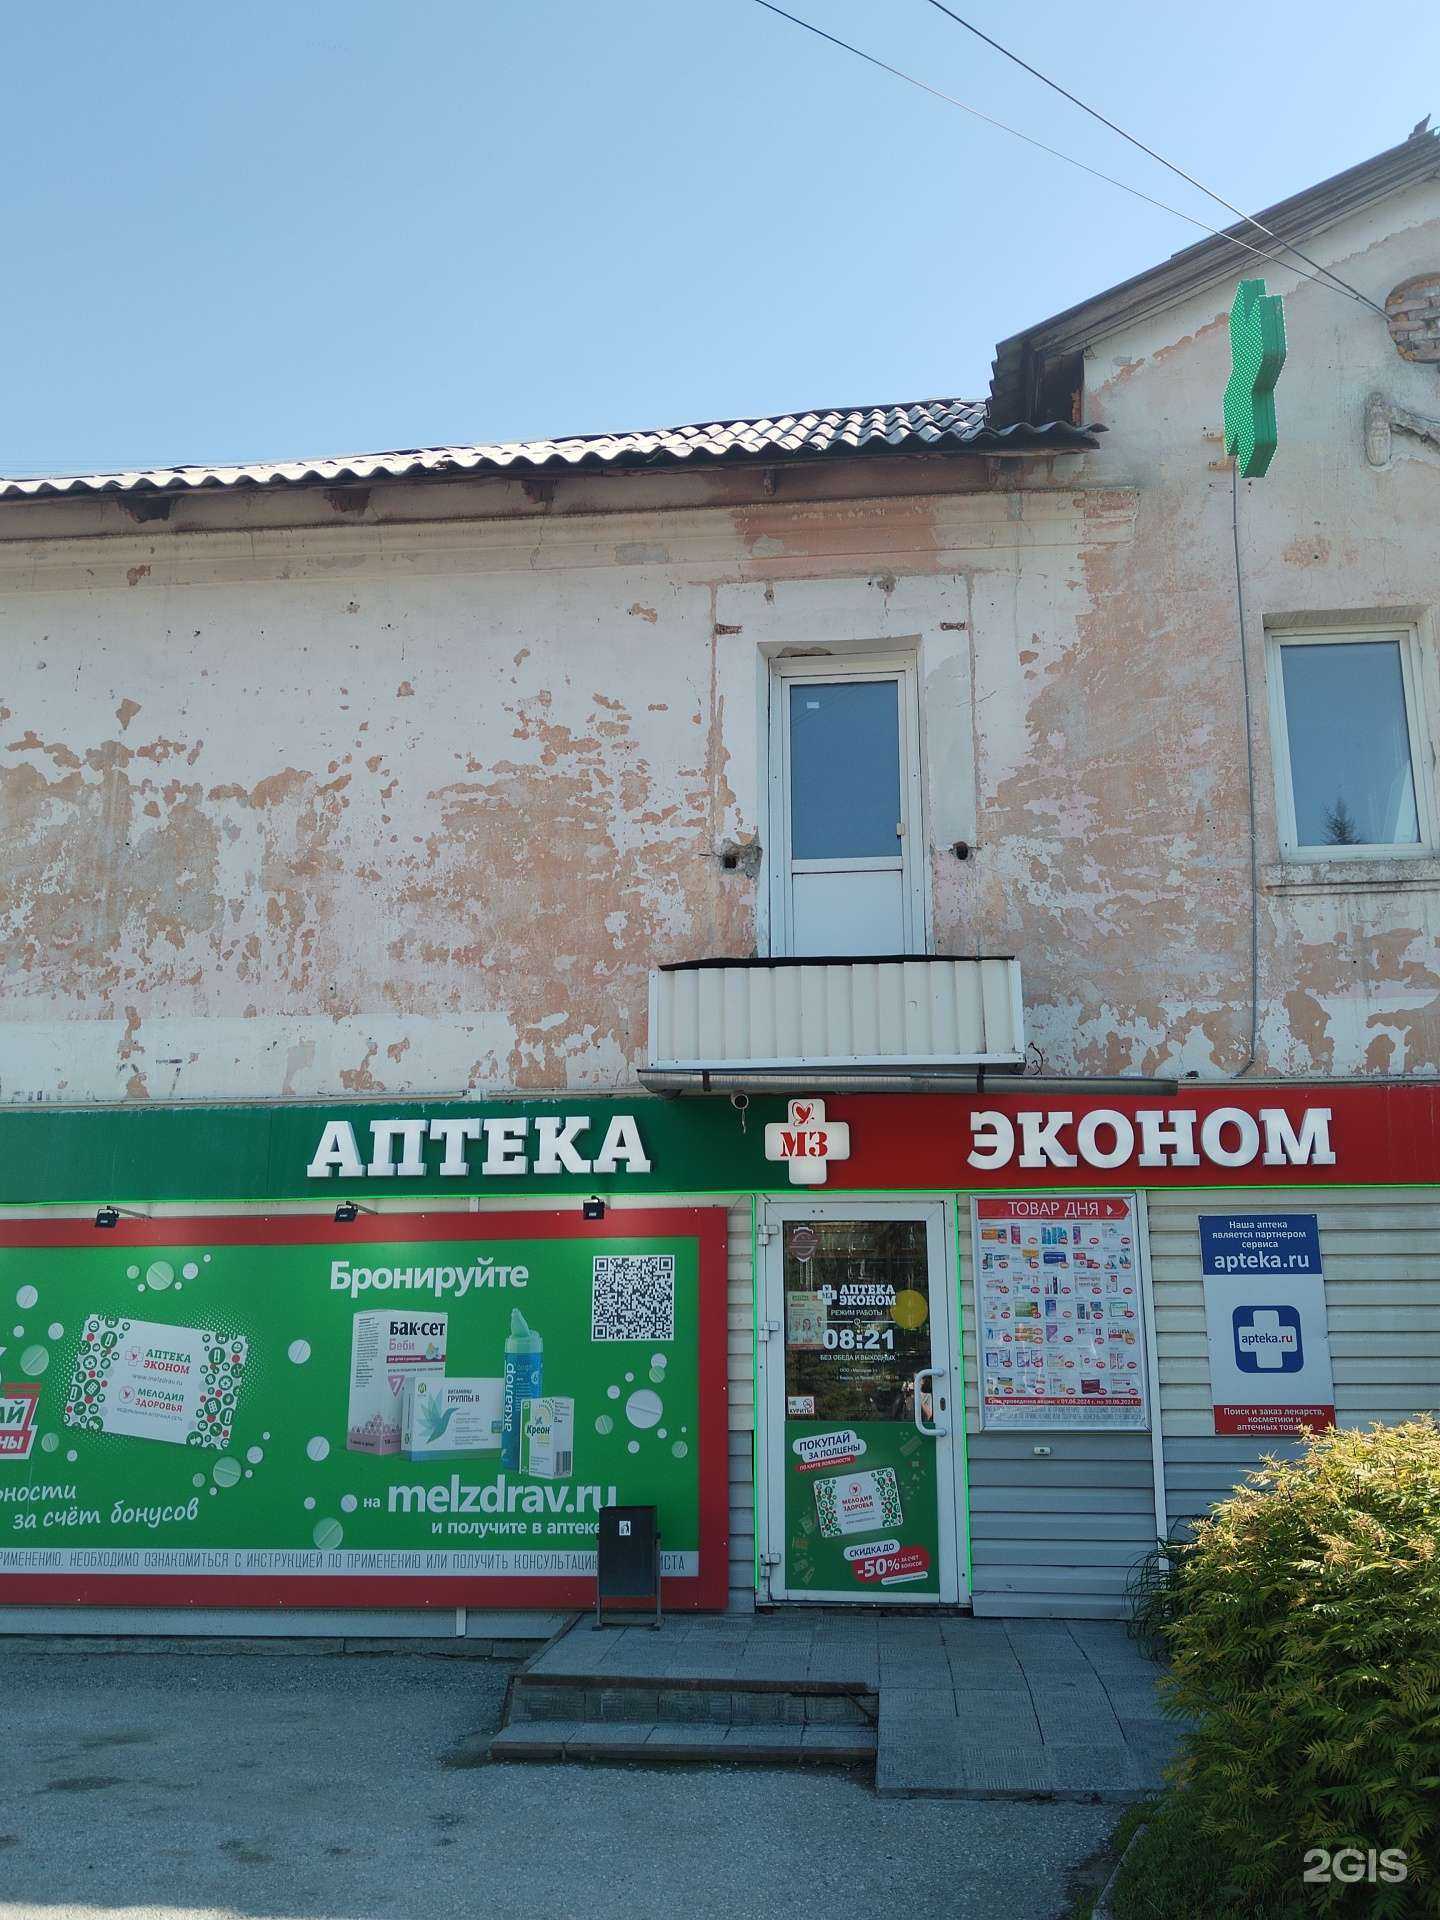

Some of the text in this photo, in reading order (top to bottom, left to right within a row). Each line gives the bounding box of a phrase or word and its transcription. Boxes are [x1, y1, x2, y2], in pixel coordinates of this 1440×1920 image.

[307, 1115, 651, 1177] АПТЕКА
[780, 1131, 828, 1157] МЗ
[968, 1107, 1336, 1171] ЭКОНОМ
[1008, 1201, 1099, 1218] ТОВАР ДНЯ
[1229, 1221, 1288, 1229] Наша аптека
[1212, 1230, 1307, 1241] является партнером
[1241, 1241, 1279, 1250] сервиса
[1214, 1251, 1309, 1272] apteka.ru
[330, 1256, 529, 1299] Бронируйте
[839, 1284, 896, 1295] АПТЕКА
[839, 1295, 897, 1306] ЭКОНОМ
[822, 1329, 894, 1350] 08:21
[1241, 1333, 1293, 1344] apteka.ru
[145, 1348, 192, 1363] АПТЕКА
[143, 1359, 191, 1375] ЭКОНОМ
[137, 1387, 185, 1402] МЕЛОДИЯ
[447, 1394, 474, 1402] ГРУППЫ
[504, 1362, 516, 1432] аквалор
[135, 1398, 183, 1413] ЗДОРОВЬЯ
[1223, 1407, 1250, 1416] Поиск
[1259, 1408, 1282, 1416] заказ
[1284, 1408, 1325, 1417] лекарств,
[1237, 1423, 1278, 1431] аптечных
[1248, 1416, 1294, 1424] косметики
[526, 1423, 550, 1436] Креон
[799, 1432, 851, 1451] ПОКУПАЙ
[808, 1444, 861, 1460] ЗА ПОЛЦЕНЫ
[363, 1474, 617, 1513] на melzdrav.ru
[841, 1495, 873, 1506] МЕЛОДИЯ
[13, 1497, 199, 1530] за счёт бонусов
[843, 1501, 874, 1512] ЗДОРОВЬЯ
[431, 1522, 600, 1538] и получите в аптеке
[850, 1543, 895, 1558] СКИДКА ДО
[69, 1552, 139, 1568] НЕОБХОДИМО
[144, 1552, 228, 1568] ОЗНАКОМИТЬСЯ
[234, 1553, 242, 1568] С
[246, 1551, 323, 1568] ИНСТРУКЦИЕЙ
[328, 1553, 342, 1568] ПО
[347, 1553, 421, 1569] ПРИМЕНЕНИЮ
[426, 1554, 448, 1569] ИЛИ
[452, 1553, 509, 1569] ПОЛУЧИТЬ
[857, 1558, 901, 1578] -50%
